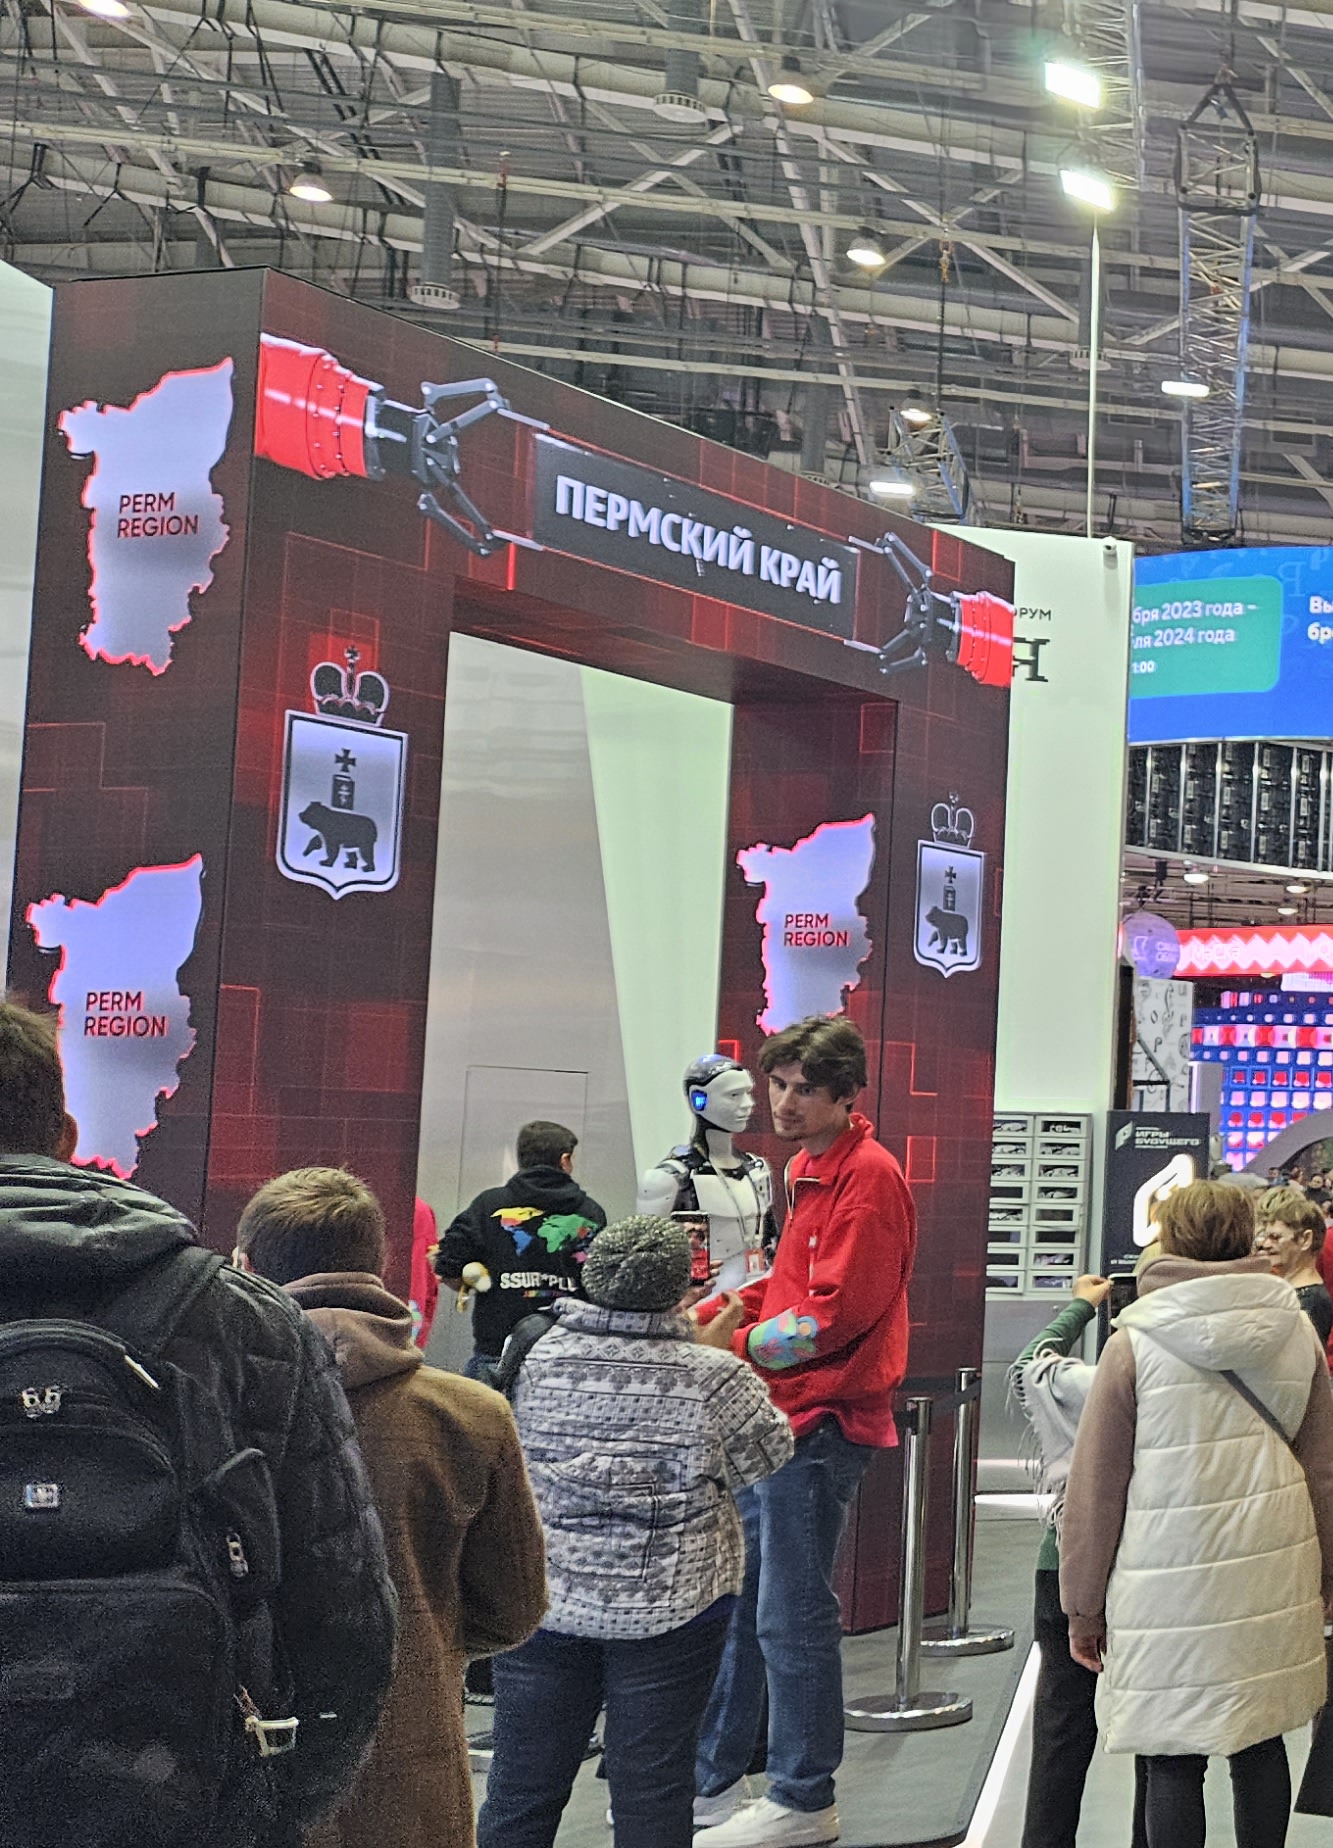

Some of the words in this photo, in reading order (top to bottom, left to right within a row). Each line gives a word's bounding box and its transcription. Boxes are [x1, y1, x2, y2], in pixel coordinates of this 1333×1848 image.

[118, 492, 176, 515] PERM
[117, 514, 199, 539] REGION
[555, 475, 756, 576] ПЕРМСКИЙ
[760, 545, 841, 604] КРАЙ
[1013, 606, 1052, 622] РУМ
[1131, 606, 1160, 627] бря
[1161, 600, 1203, 621] 2023
[1205, 602, 1245, 618] года
[1131, 634, 1152, 649] ля
[1153, 627, 1197, 648] 2024
[1197, 629, 1237, 645] года
[1131, 660, 1156, 674] 1:00
[784, 913, 830, 930] PERM
[783, 930, 849, 948] REGION
[85, 991, 143, 1012] PERM
[84, 1015, 167, 1037] REGION
